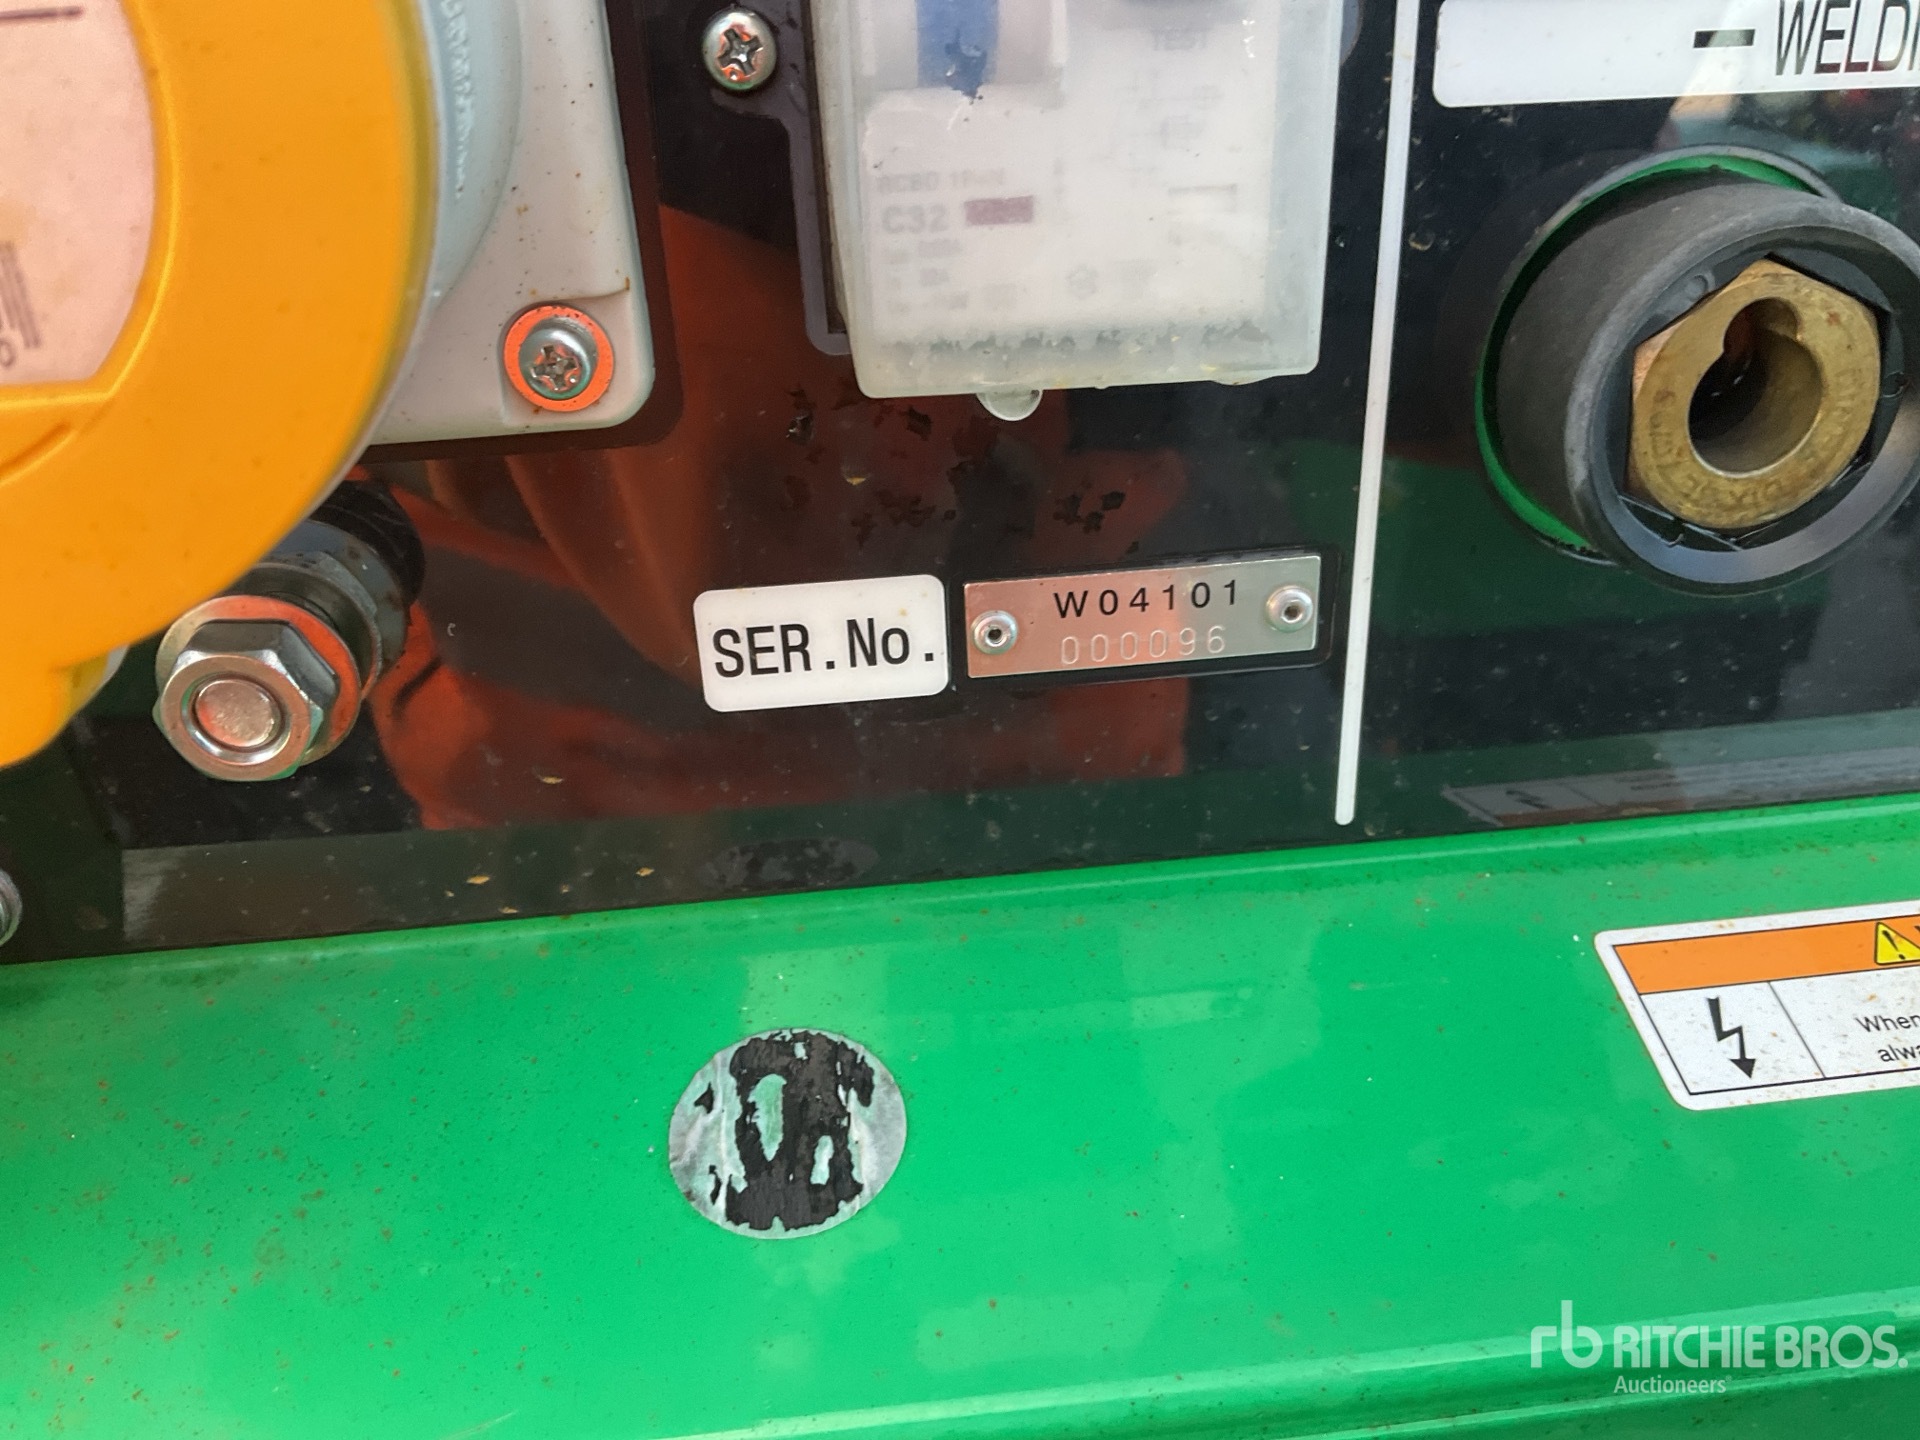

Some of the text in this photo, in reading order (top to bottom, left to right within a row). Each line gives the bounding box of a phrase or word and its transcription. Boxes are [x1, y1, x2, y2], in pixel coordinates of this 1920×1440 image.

[1054, 579, 1239, 618] W04101
[1061, 625, 1227, 666] 000096
[1878, 1044, 1920, 1062] alw
